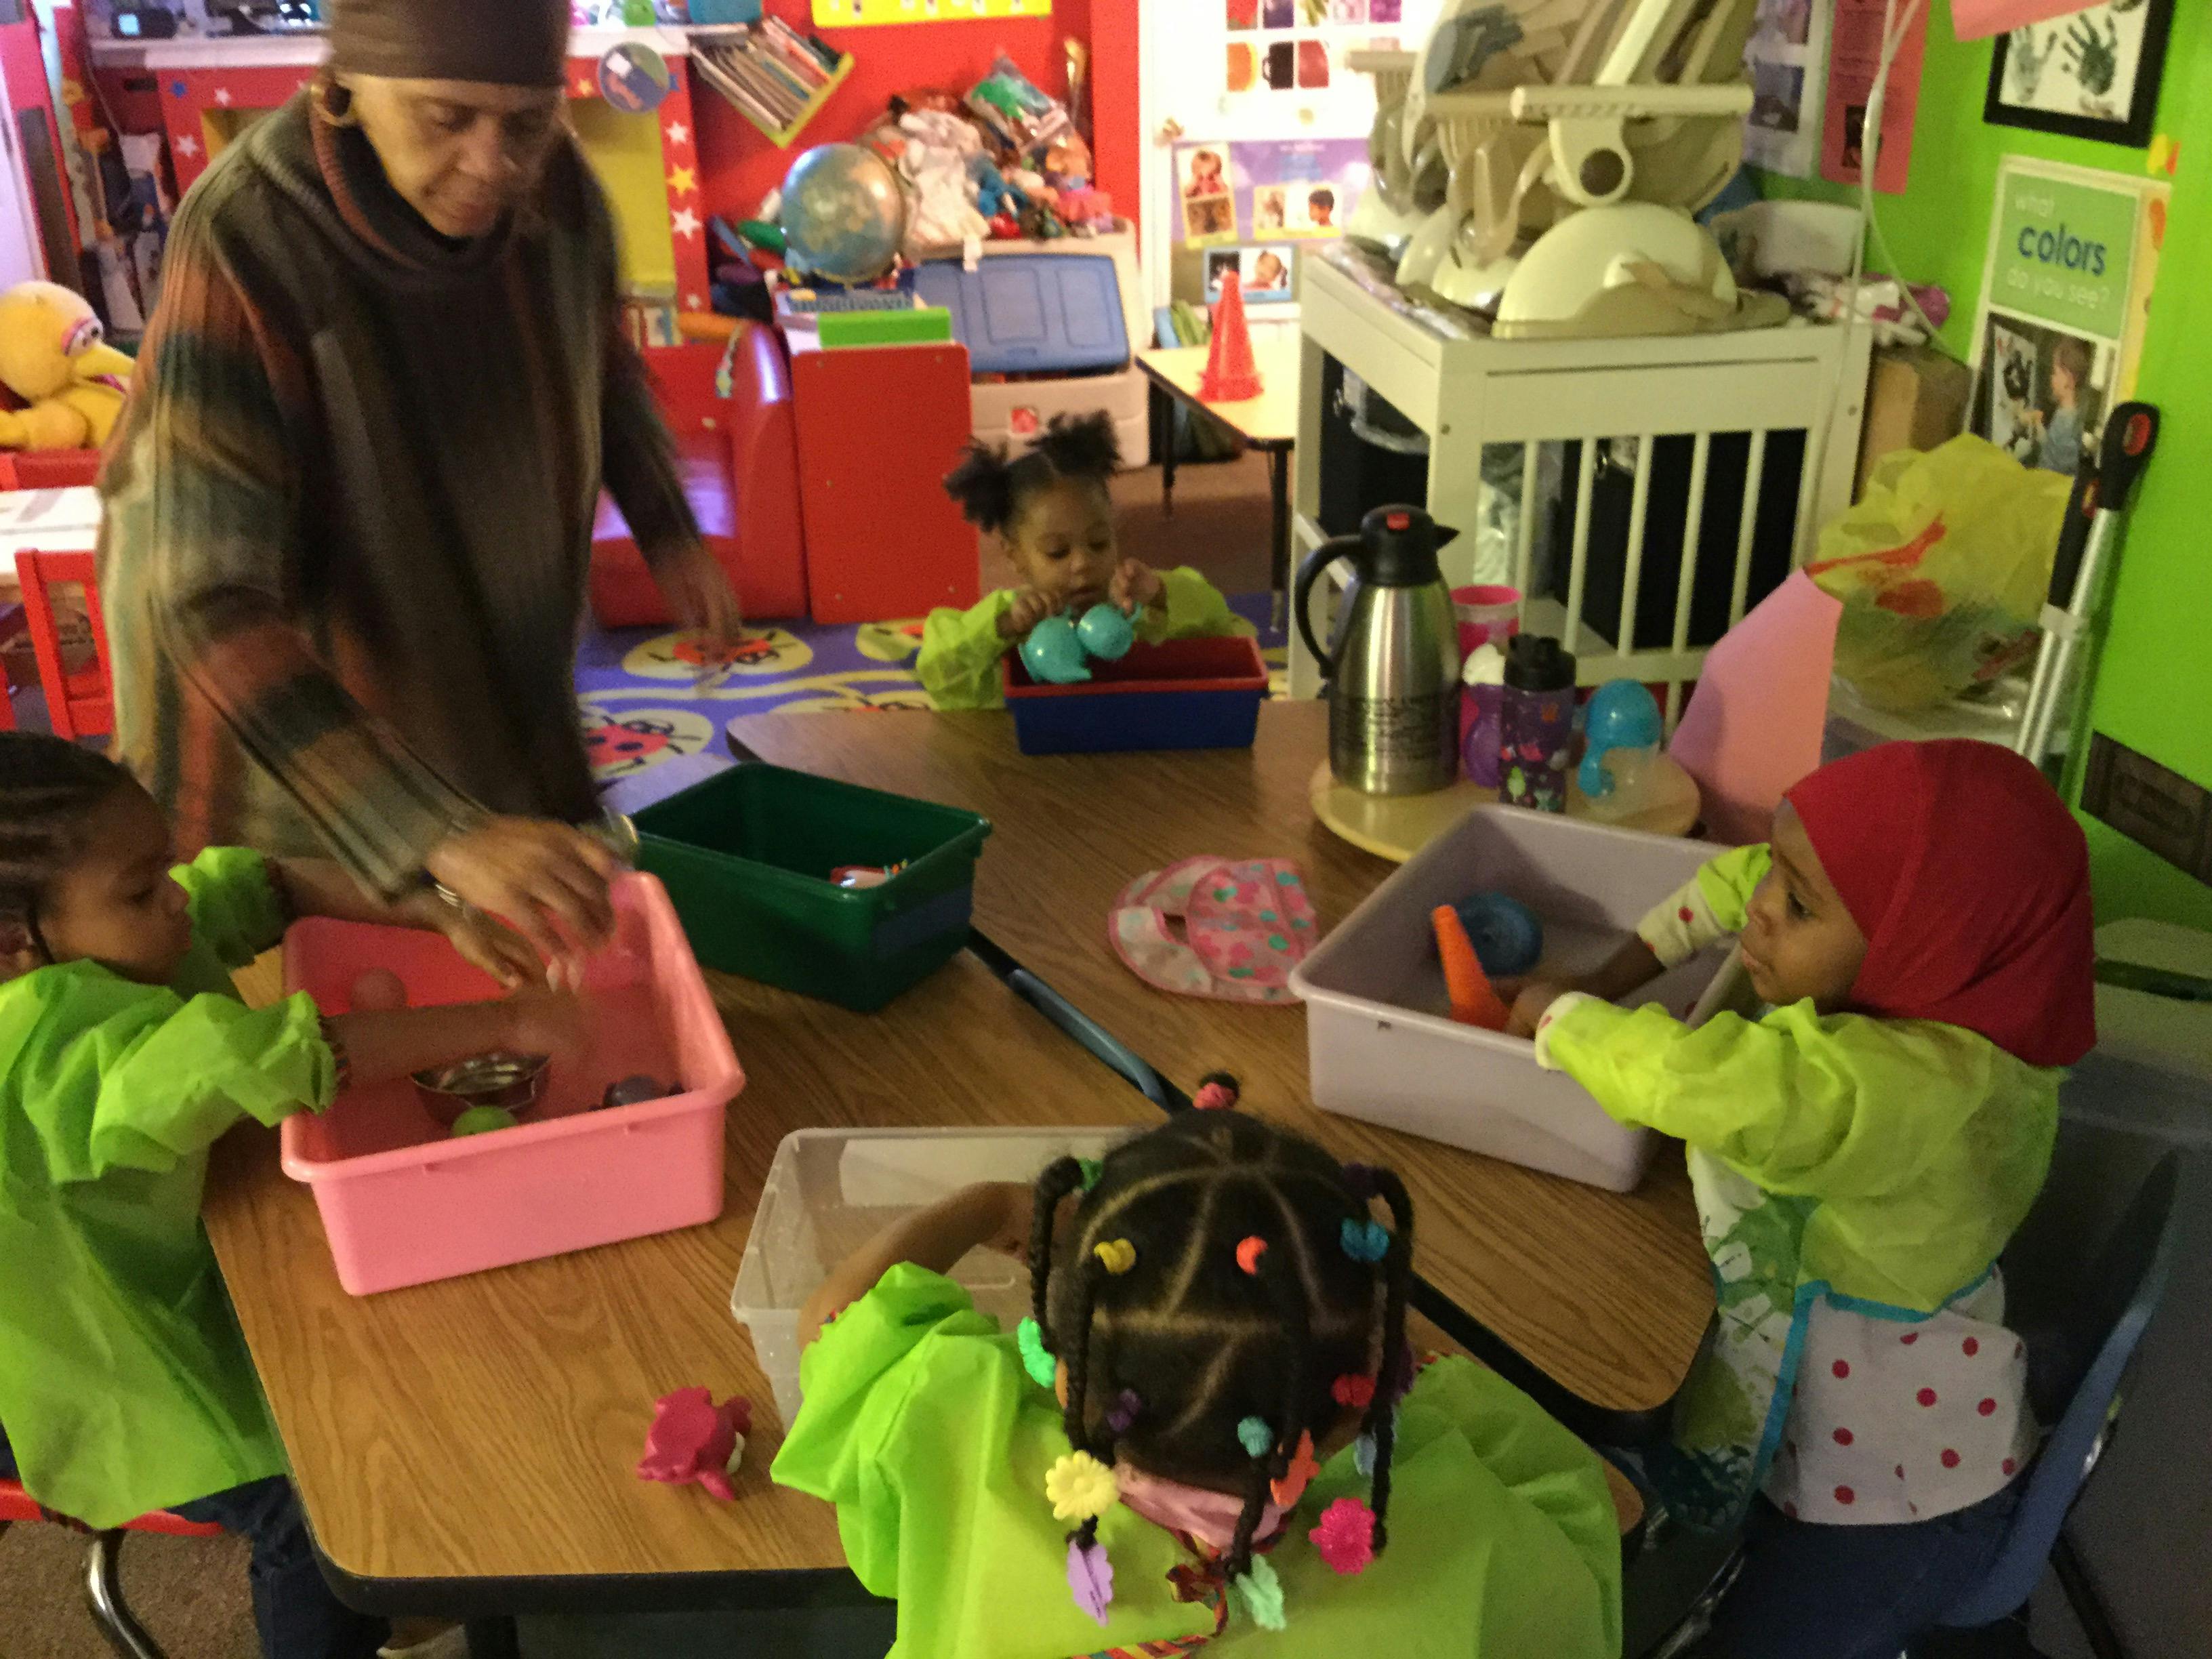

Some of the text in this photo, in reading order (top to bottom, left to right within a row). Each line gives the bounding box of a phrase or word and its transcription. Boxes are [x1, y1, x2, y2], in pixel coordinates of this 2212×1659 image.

[2014, 194, 2055, 218] what
[2018, 222, 2107, 276] colors
[2007, 265, 2029, 289] do
[2033, 276, 2064, 301] you
